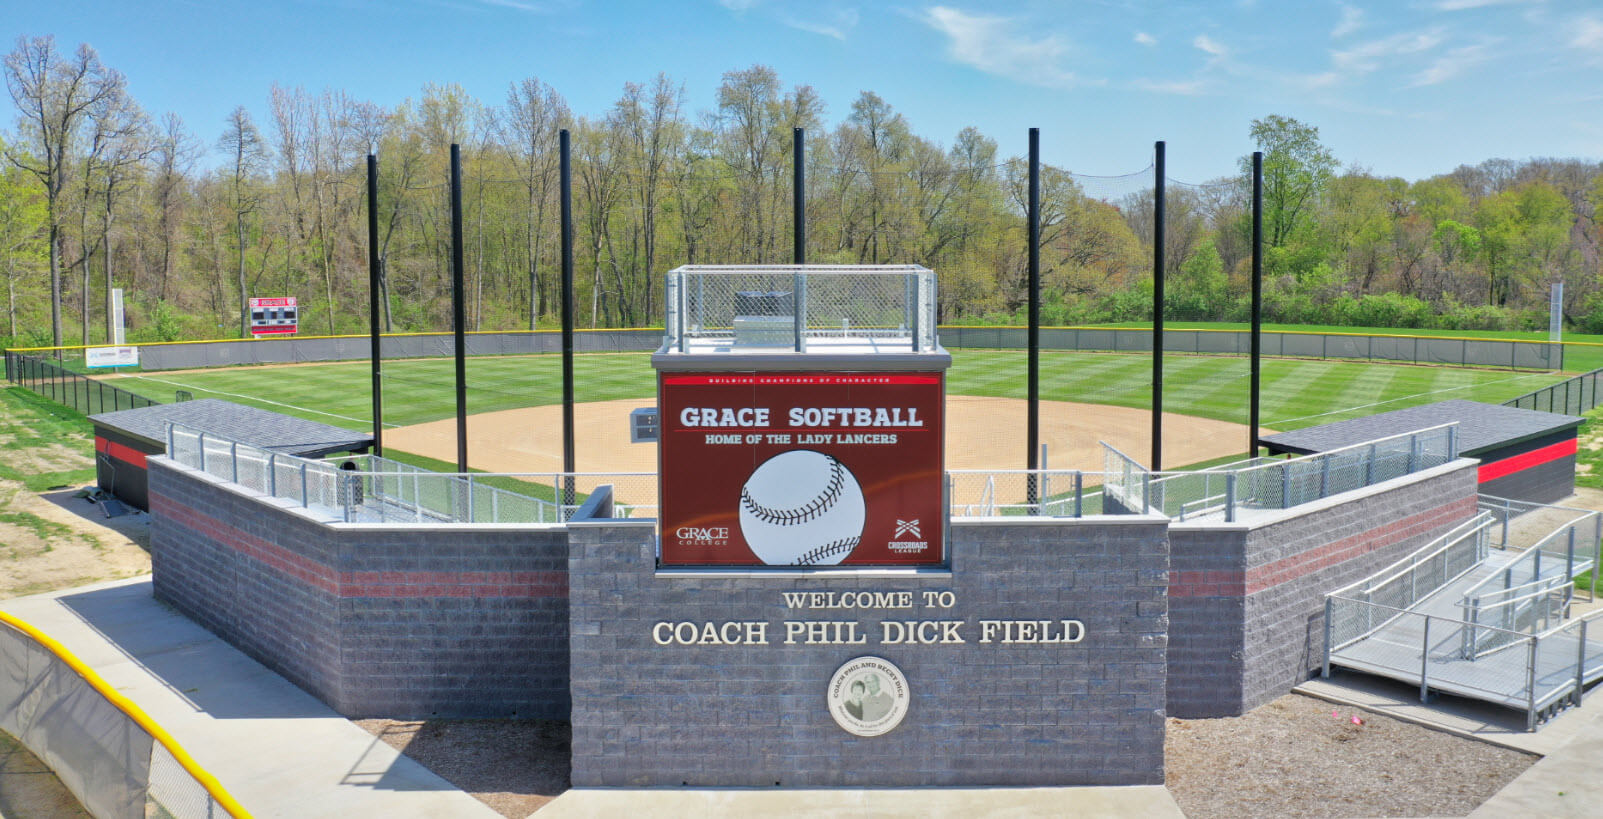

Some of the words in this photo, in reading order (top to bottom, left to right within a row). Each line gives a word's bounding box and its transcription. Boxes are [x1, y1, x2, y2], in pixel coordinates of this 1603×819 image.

[680, 408, 769, 427] GRACE
[788, 408, 923, 427] SOFTBALL
[705, 434, 742, 444] HOME
[746, 434, 762, 444] OF
[766, 434, 791, 444] THE
[797, 434, 832, 444] LADY
[837, 434, 897, 444] LANCERS
[676, 527, 728, 540] GRACE
[782, 592, 912, 609] WELCOME
[923, 592, 955, 609] TO
[652, 621, 769, 645] COACH
[784, 621, 866, 645] PHIL
[880, 621, 965, 645] DICK
[979, 621, 1085, 645] FIELD
[833, 675, 845, 698] COACH
[844, 664, 861, 676] PHIL
[895, 680, 903, 698] DICK
